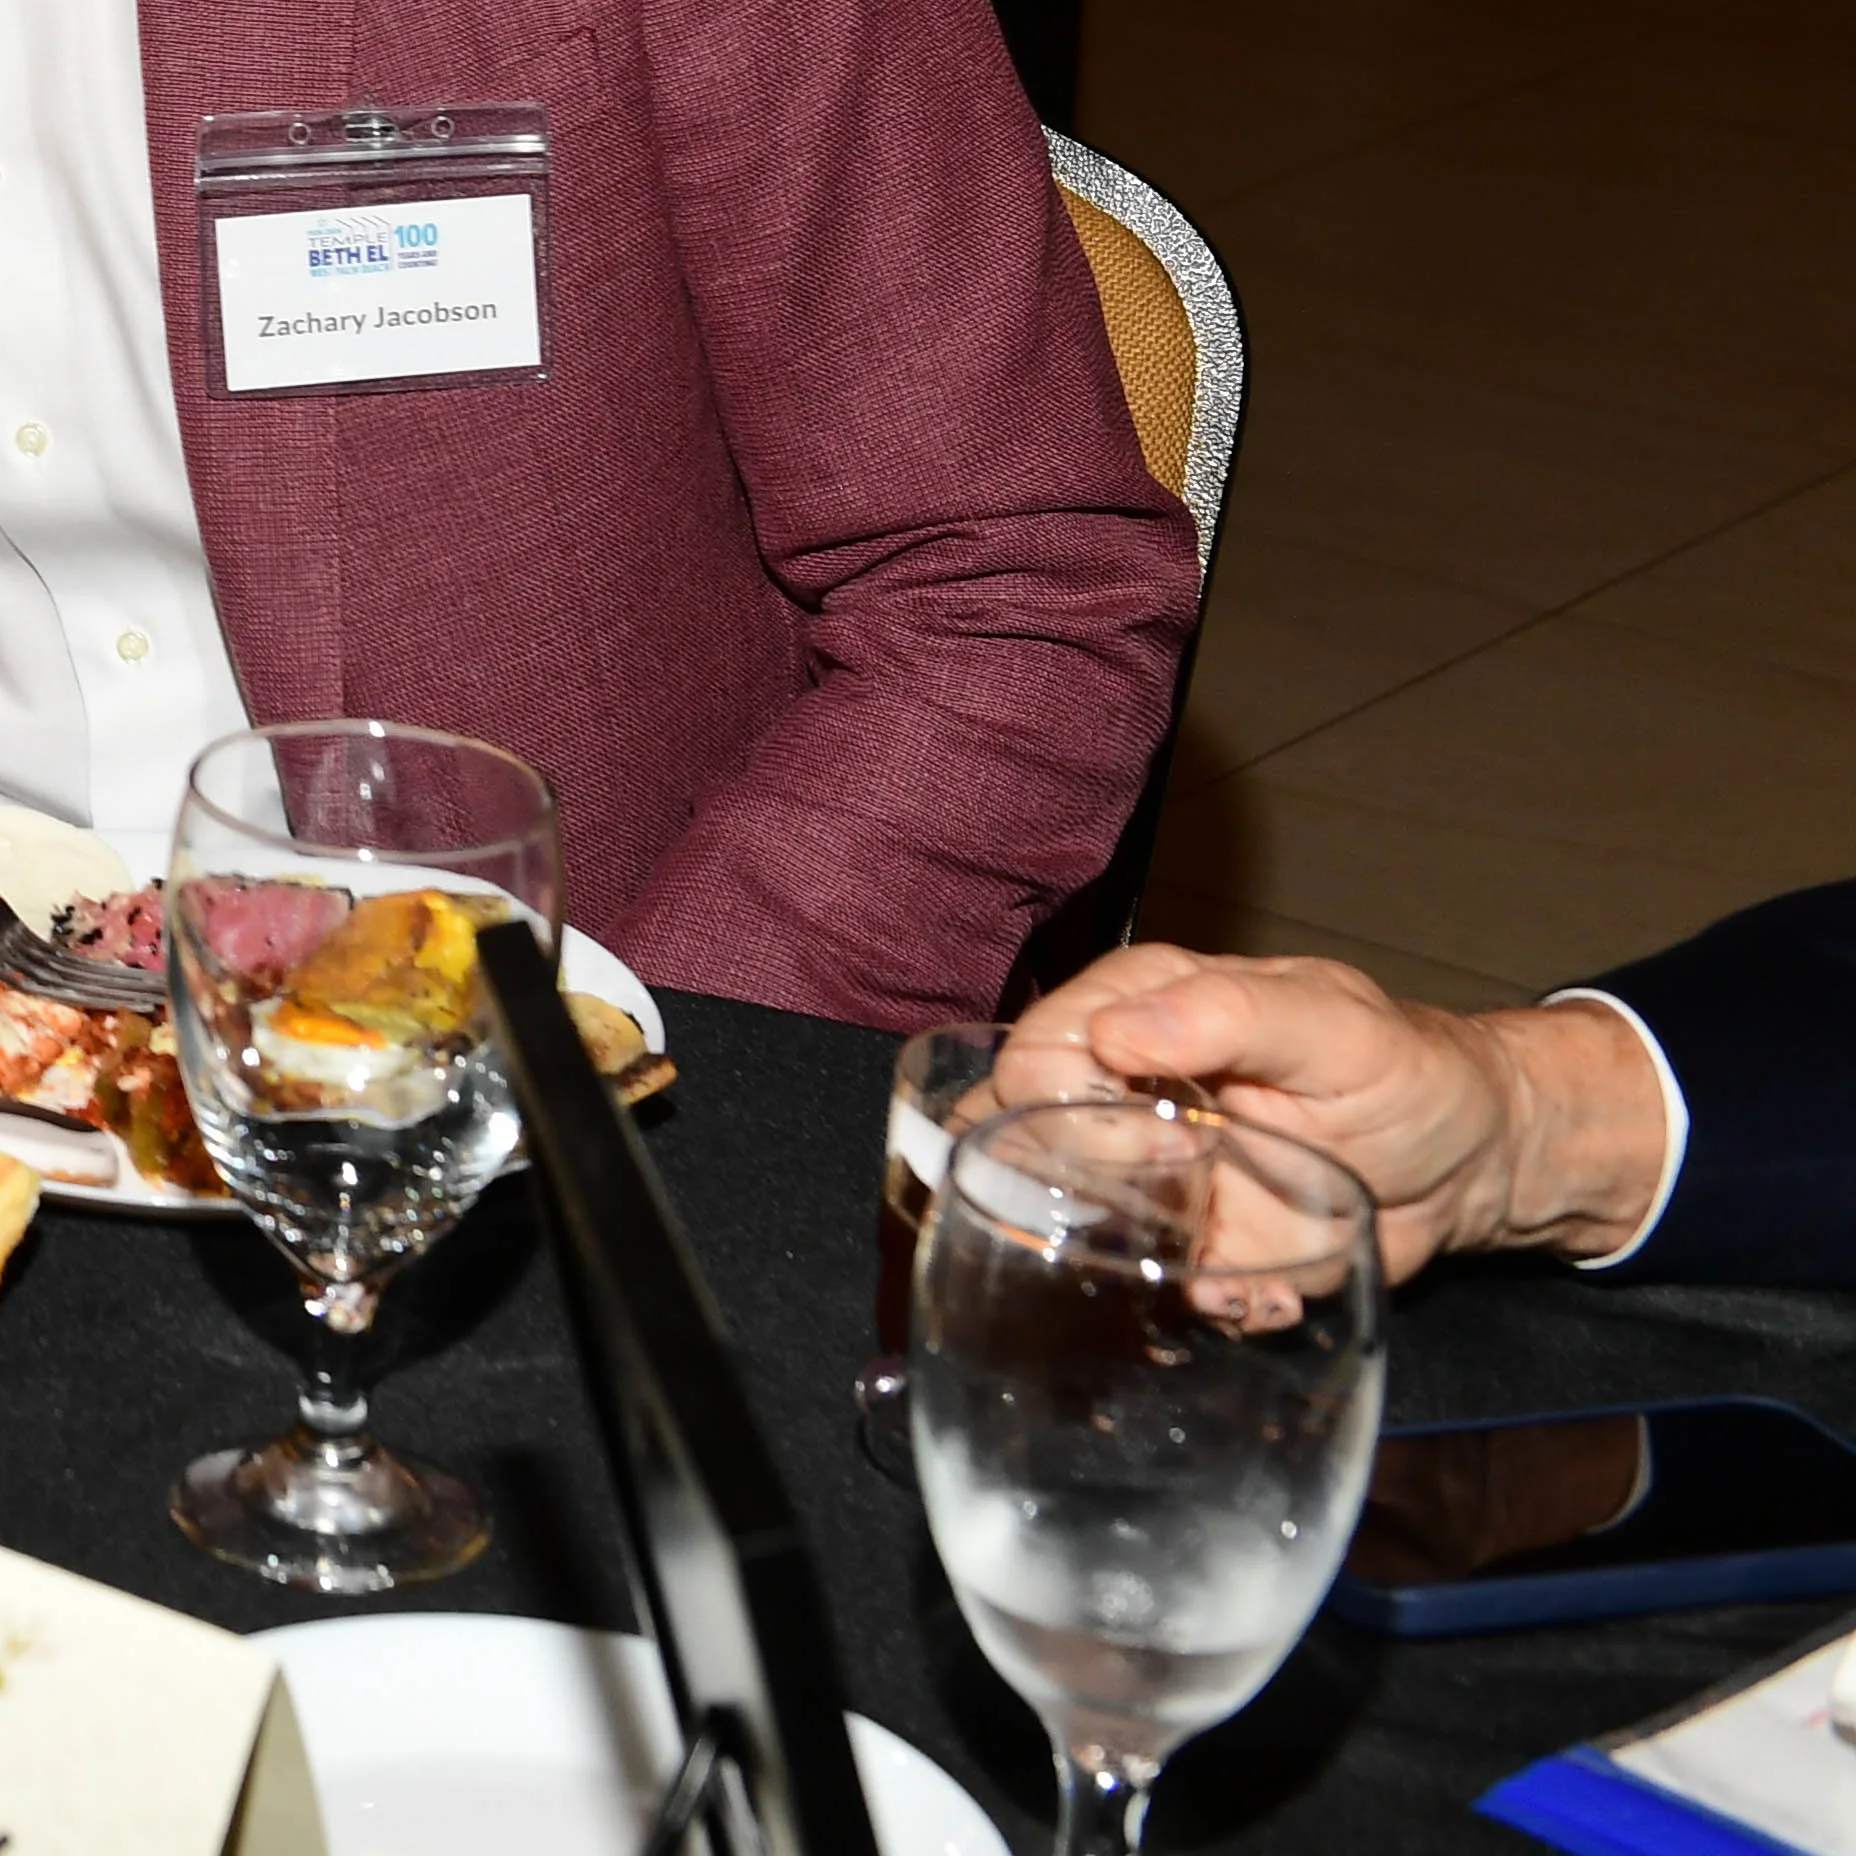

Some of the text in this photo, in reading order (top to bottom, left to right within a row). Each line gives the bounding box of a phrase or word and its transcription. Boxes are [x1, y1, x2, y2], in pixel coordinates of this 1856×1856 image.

[308, 232, 388, 248] TEMPLE
[395, 223, 437, 248] 100
[308, 244, 389, 267] BETH EL
[257, 301, 498, 338] Zachary Jacobson
